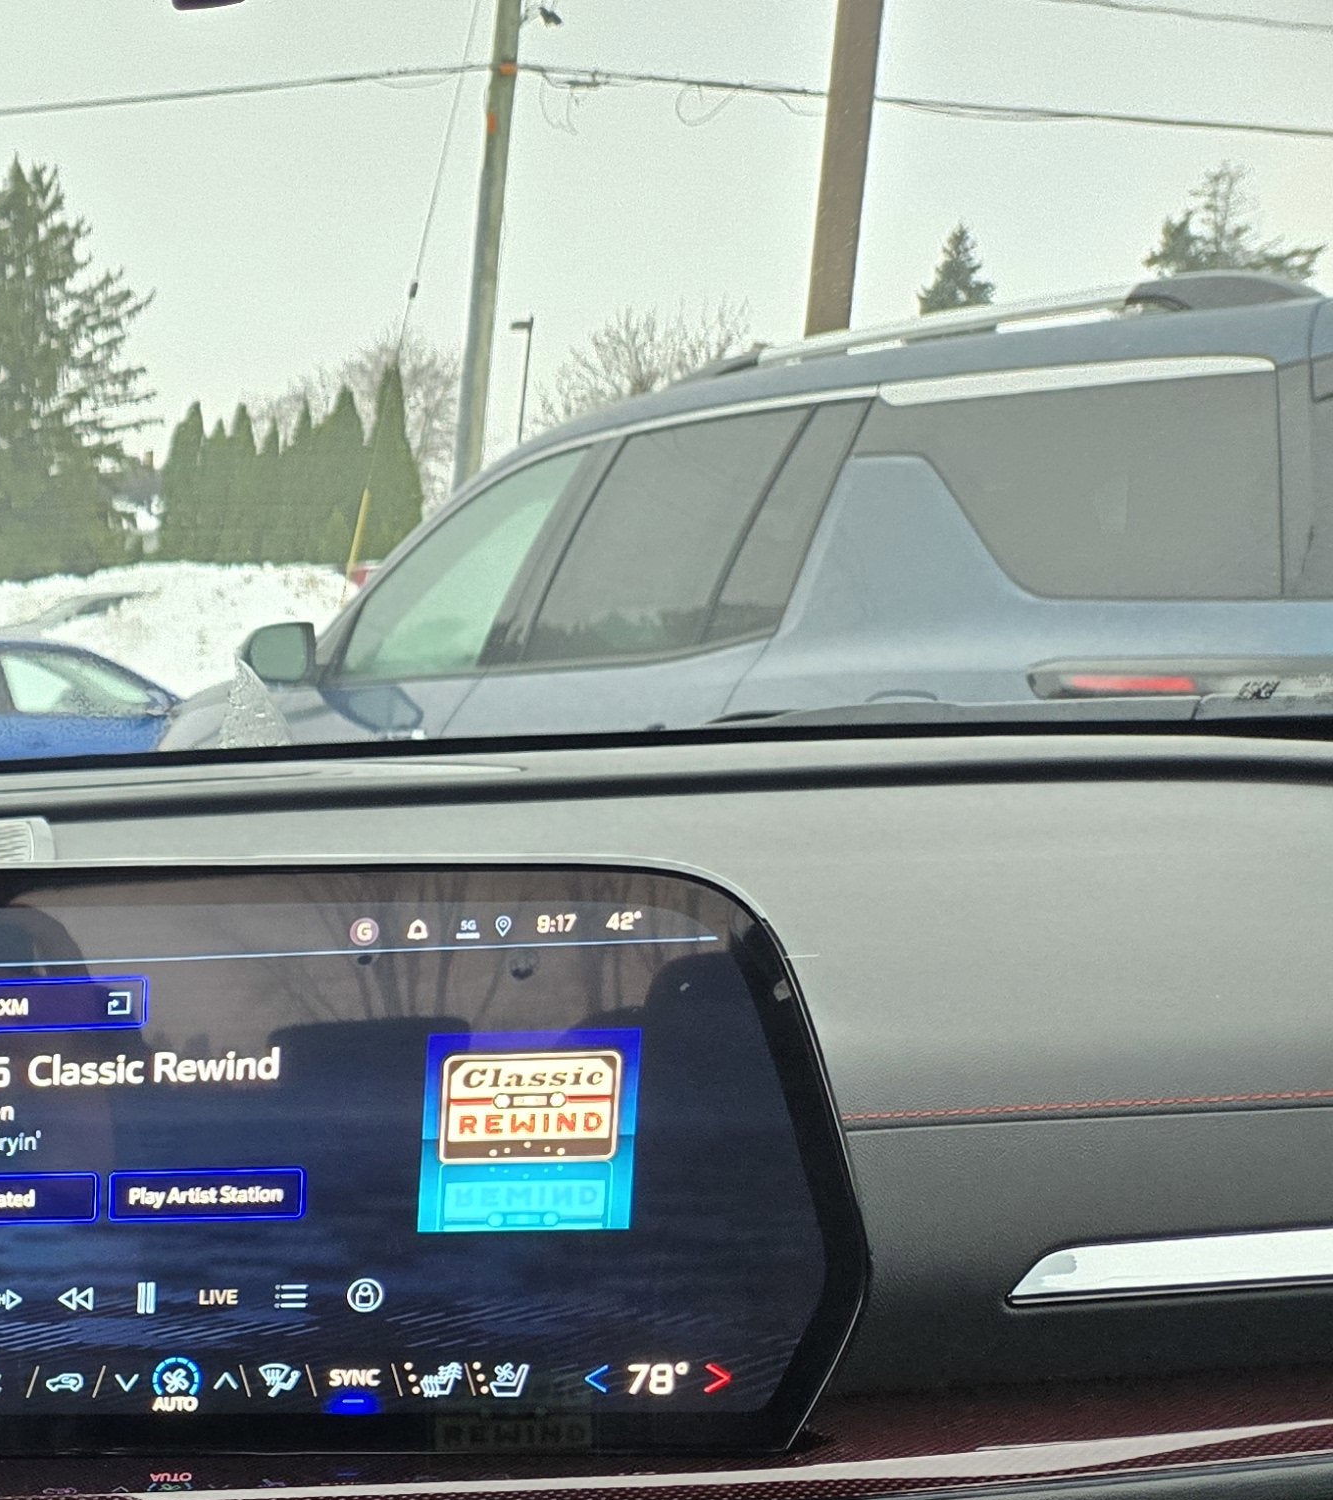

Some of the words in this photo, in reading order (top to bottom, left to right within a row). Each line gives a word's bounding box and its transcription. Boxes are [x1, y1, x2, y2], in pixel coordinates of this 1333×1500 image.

[460, 919, 478, 932] 5G
[27, 1053, 145, 1088] Classic
[153, 1046, 281, 1084] Rewind
[462, 1067, 605, 1090] Classic
[458, 1111, 604, 1135] REWIND
[129, 1187, 165, 1209] Play
[167, 1185, 217, 1206] Artist
[220, 1184, 284, 1204] Station
[198, 1289, 239, 1306] LIVE
[328, 1368, 382, 1388] SYNC
[626, 1361, 689, 1395] 78°
[151, 1395, 200, 1412] AUTO
